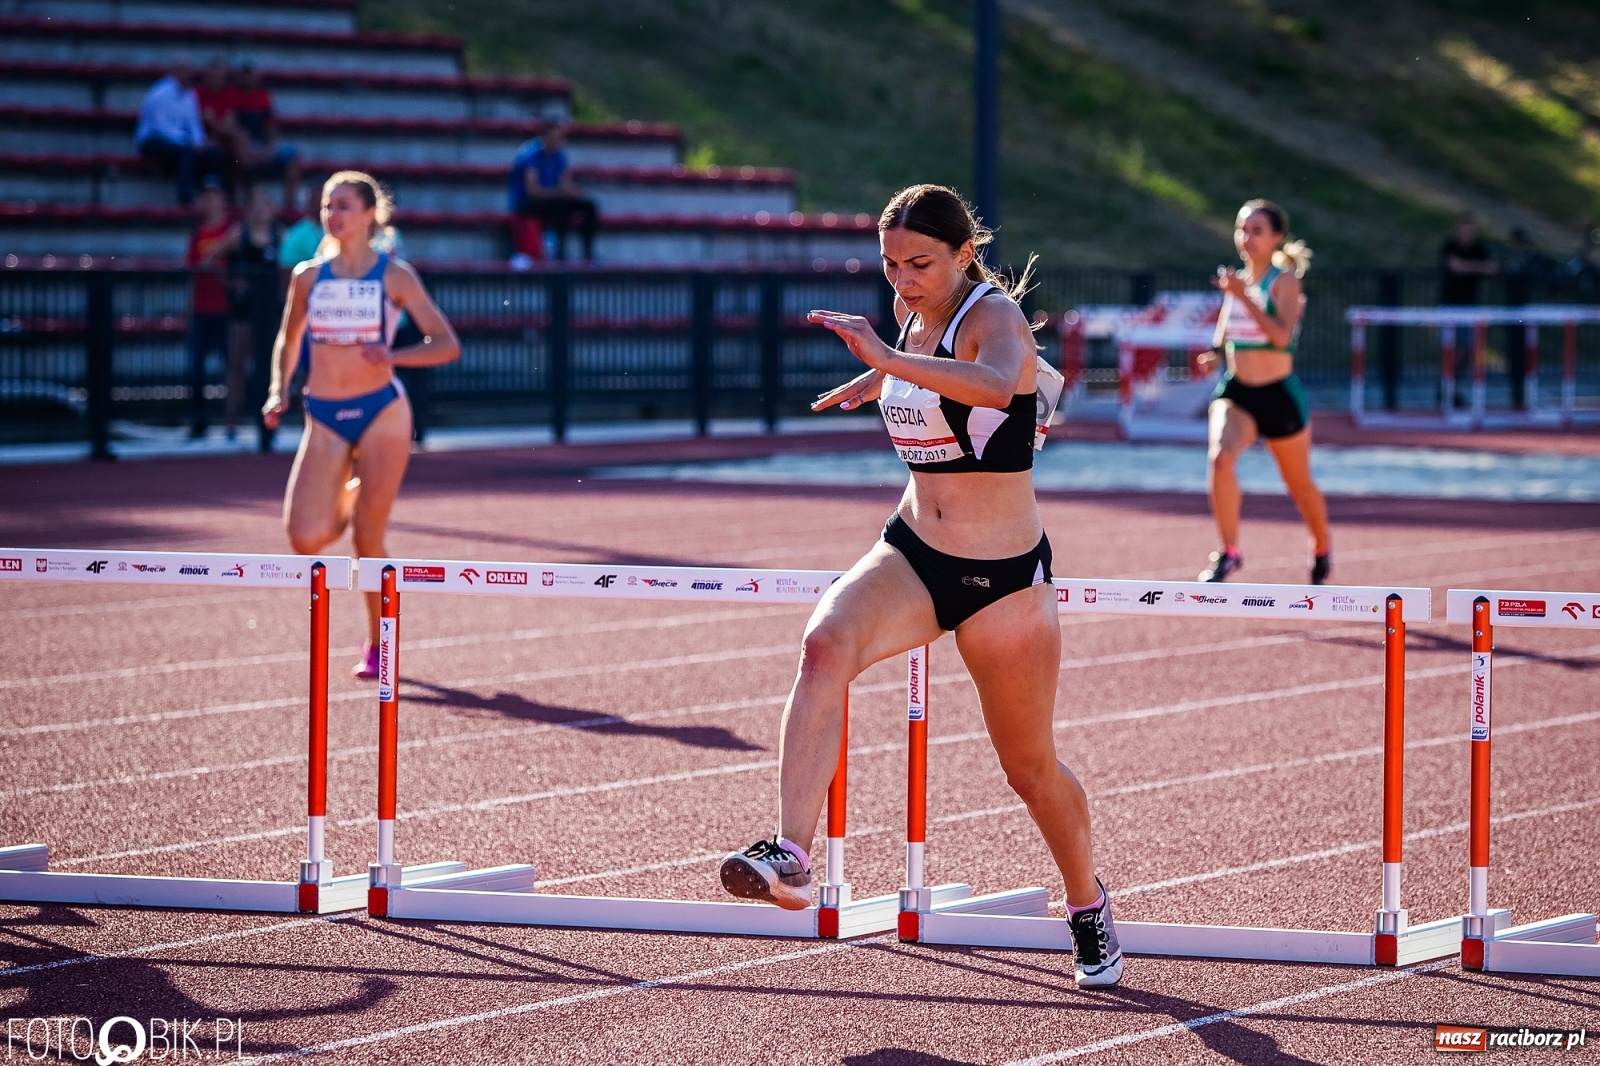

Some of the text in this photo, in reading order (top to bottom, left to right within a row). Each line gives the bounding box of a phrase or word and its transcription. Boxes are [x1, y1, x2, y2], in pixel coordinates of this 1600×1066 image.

[883, 404, 928, 428] KĘDZIA
[924, 449, 947, 461] 2019
[0, 560, 20, 571] LEN
[86, 560, 108, 573] 4F
[488, 572, 526, 584] ORLEN
[594, 574, 617, 588] 4F
[1139, 591, 1164, 605] 4F
[380, 639, 390, 686] polanik
[910, 656, 921, 704] polanik
[1474, 674, 1486, 724] polanik
